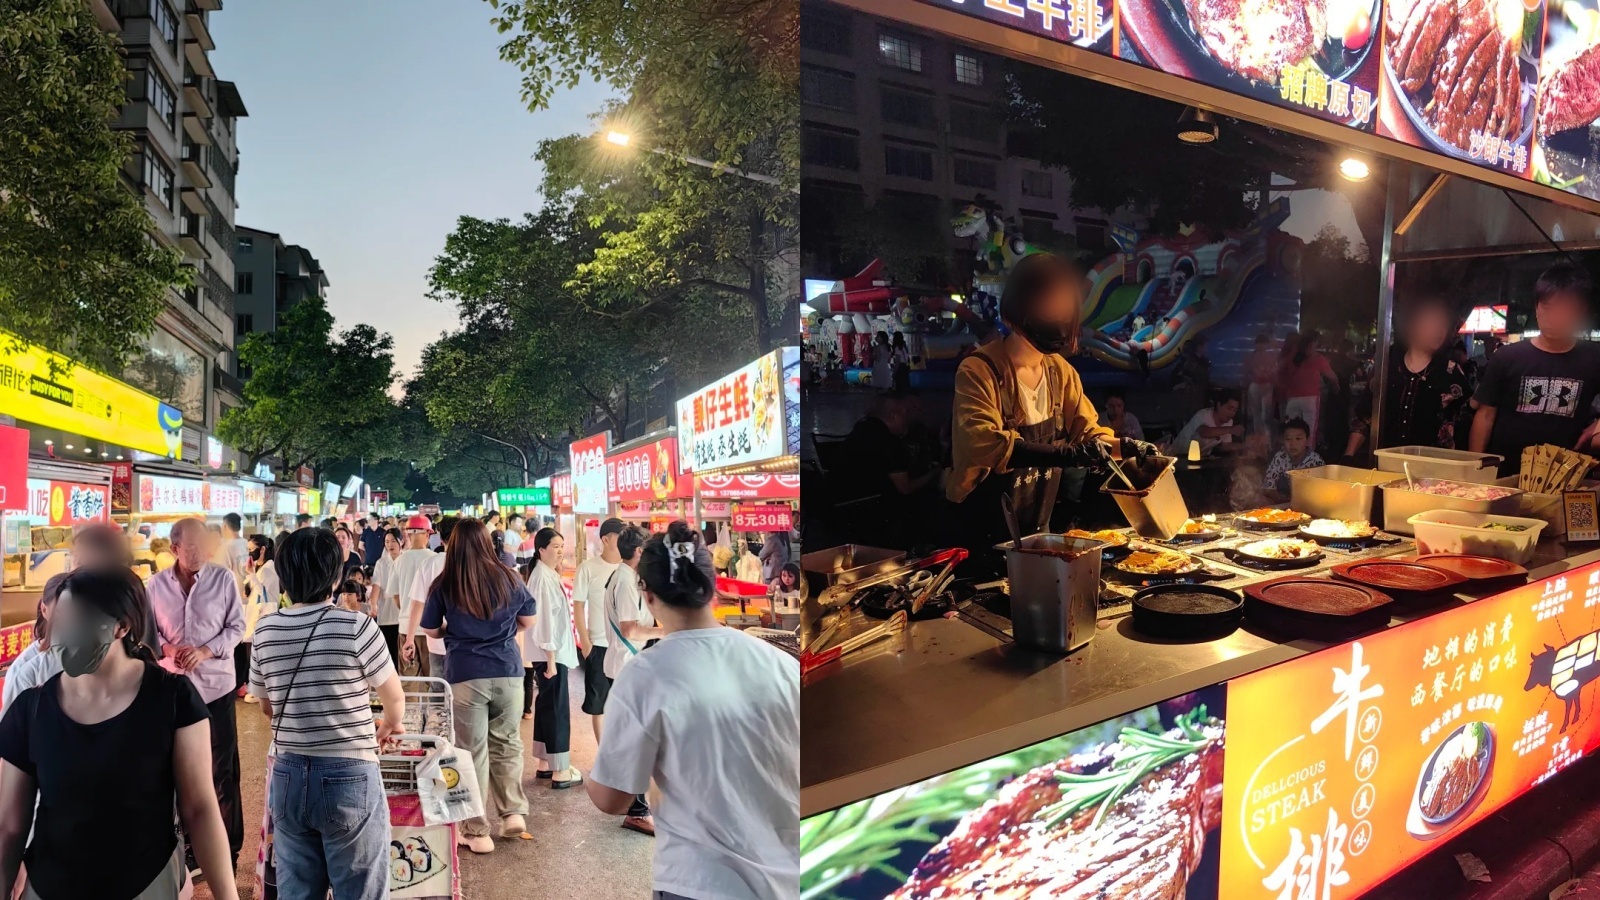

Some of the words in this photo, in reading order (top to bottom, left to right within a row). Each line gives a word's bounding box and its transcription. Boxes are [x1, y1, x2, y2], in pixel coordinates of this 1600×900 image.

[1280, 62, 1371, 123] 招牌原切
[1469, 128, 1528, 173] 沙朗牛排
[49, 384, 61, 399] FOR
[61, 387, 73, 403] YOU
[693, 372, 750, 435] 靓仔生蚝
[735, 513, 790, 527] 8元30串
[1422, 613, 1514, 670] 地摊的消费
[1410, 644, 1517, 707] 西餐厅的口味
[1251, 779, 1326, 833] STEAK
[1353, 712, 1378, 849] 新鲜美味
